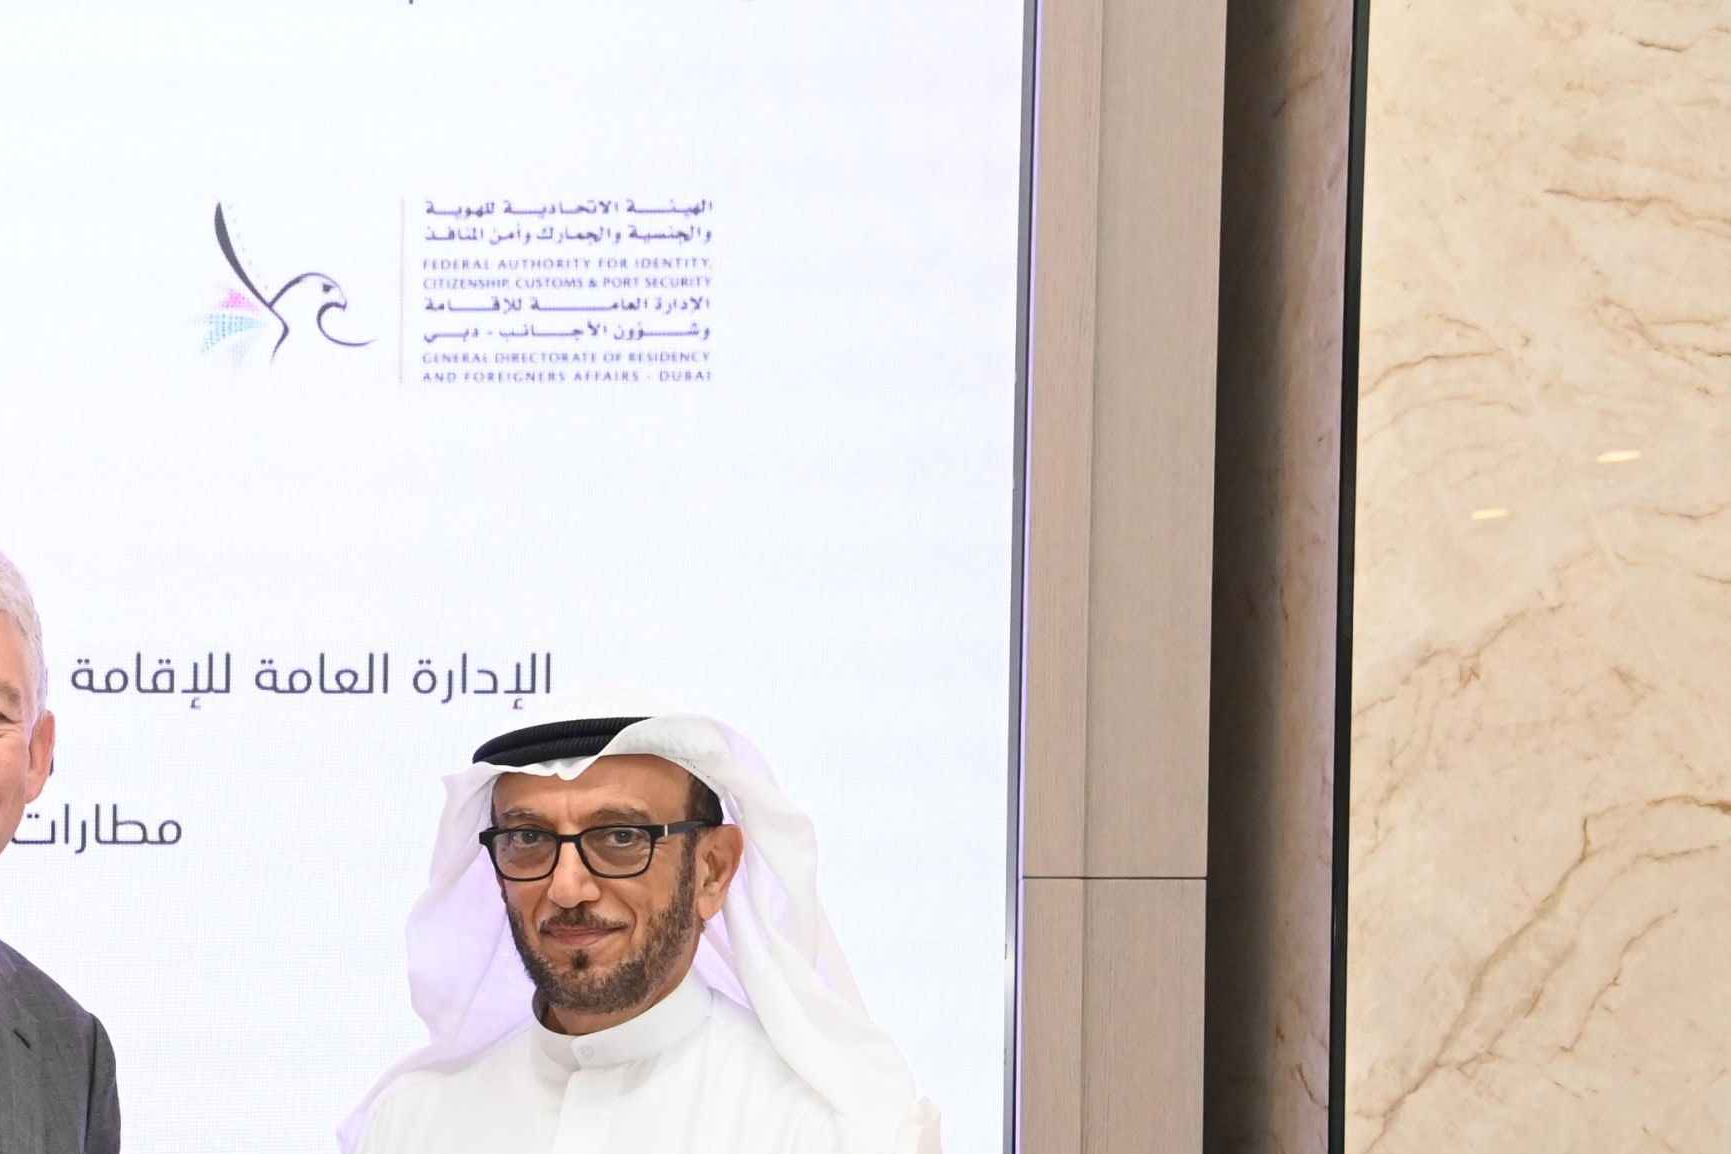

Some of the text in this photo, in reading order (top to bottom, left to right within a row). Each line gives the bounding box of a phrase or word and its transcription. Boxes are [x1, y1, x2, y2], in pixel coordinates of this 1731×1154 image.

[423, 259, 489, 270] FEDERAL
[498, 259, 591, 270] AUTHORITY
[598, 259, 628, 270] FOR
[516, 277, 583, 289] CUSTOMS
[588, 277, 597, 288] &
[603, 277, 638, 288] PORT
[645, 277, 712, 289] SECURITY
[530, 296, 648, 311] العامة
[424, 328, 479, 343] دبي
[422, 352, 710, 364] GENERAL DIRECTORATE OF RESIDENCY
[423, 371, 456, 382] AND
[464, 371, 565, 382] FOREIGNERS
[574, 371, 639, 382] AFFAIRS
[660, 371, 712, 382] DUBAI
[71, 652, 550, 710] الإدارة العامة للإقامة
[11, 803, 182, 855] مطارات
